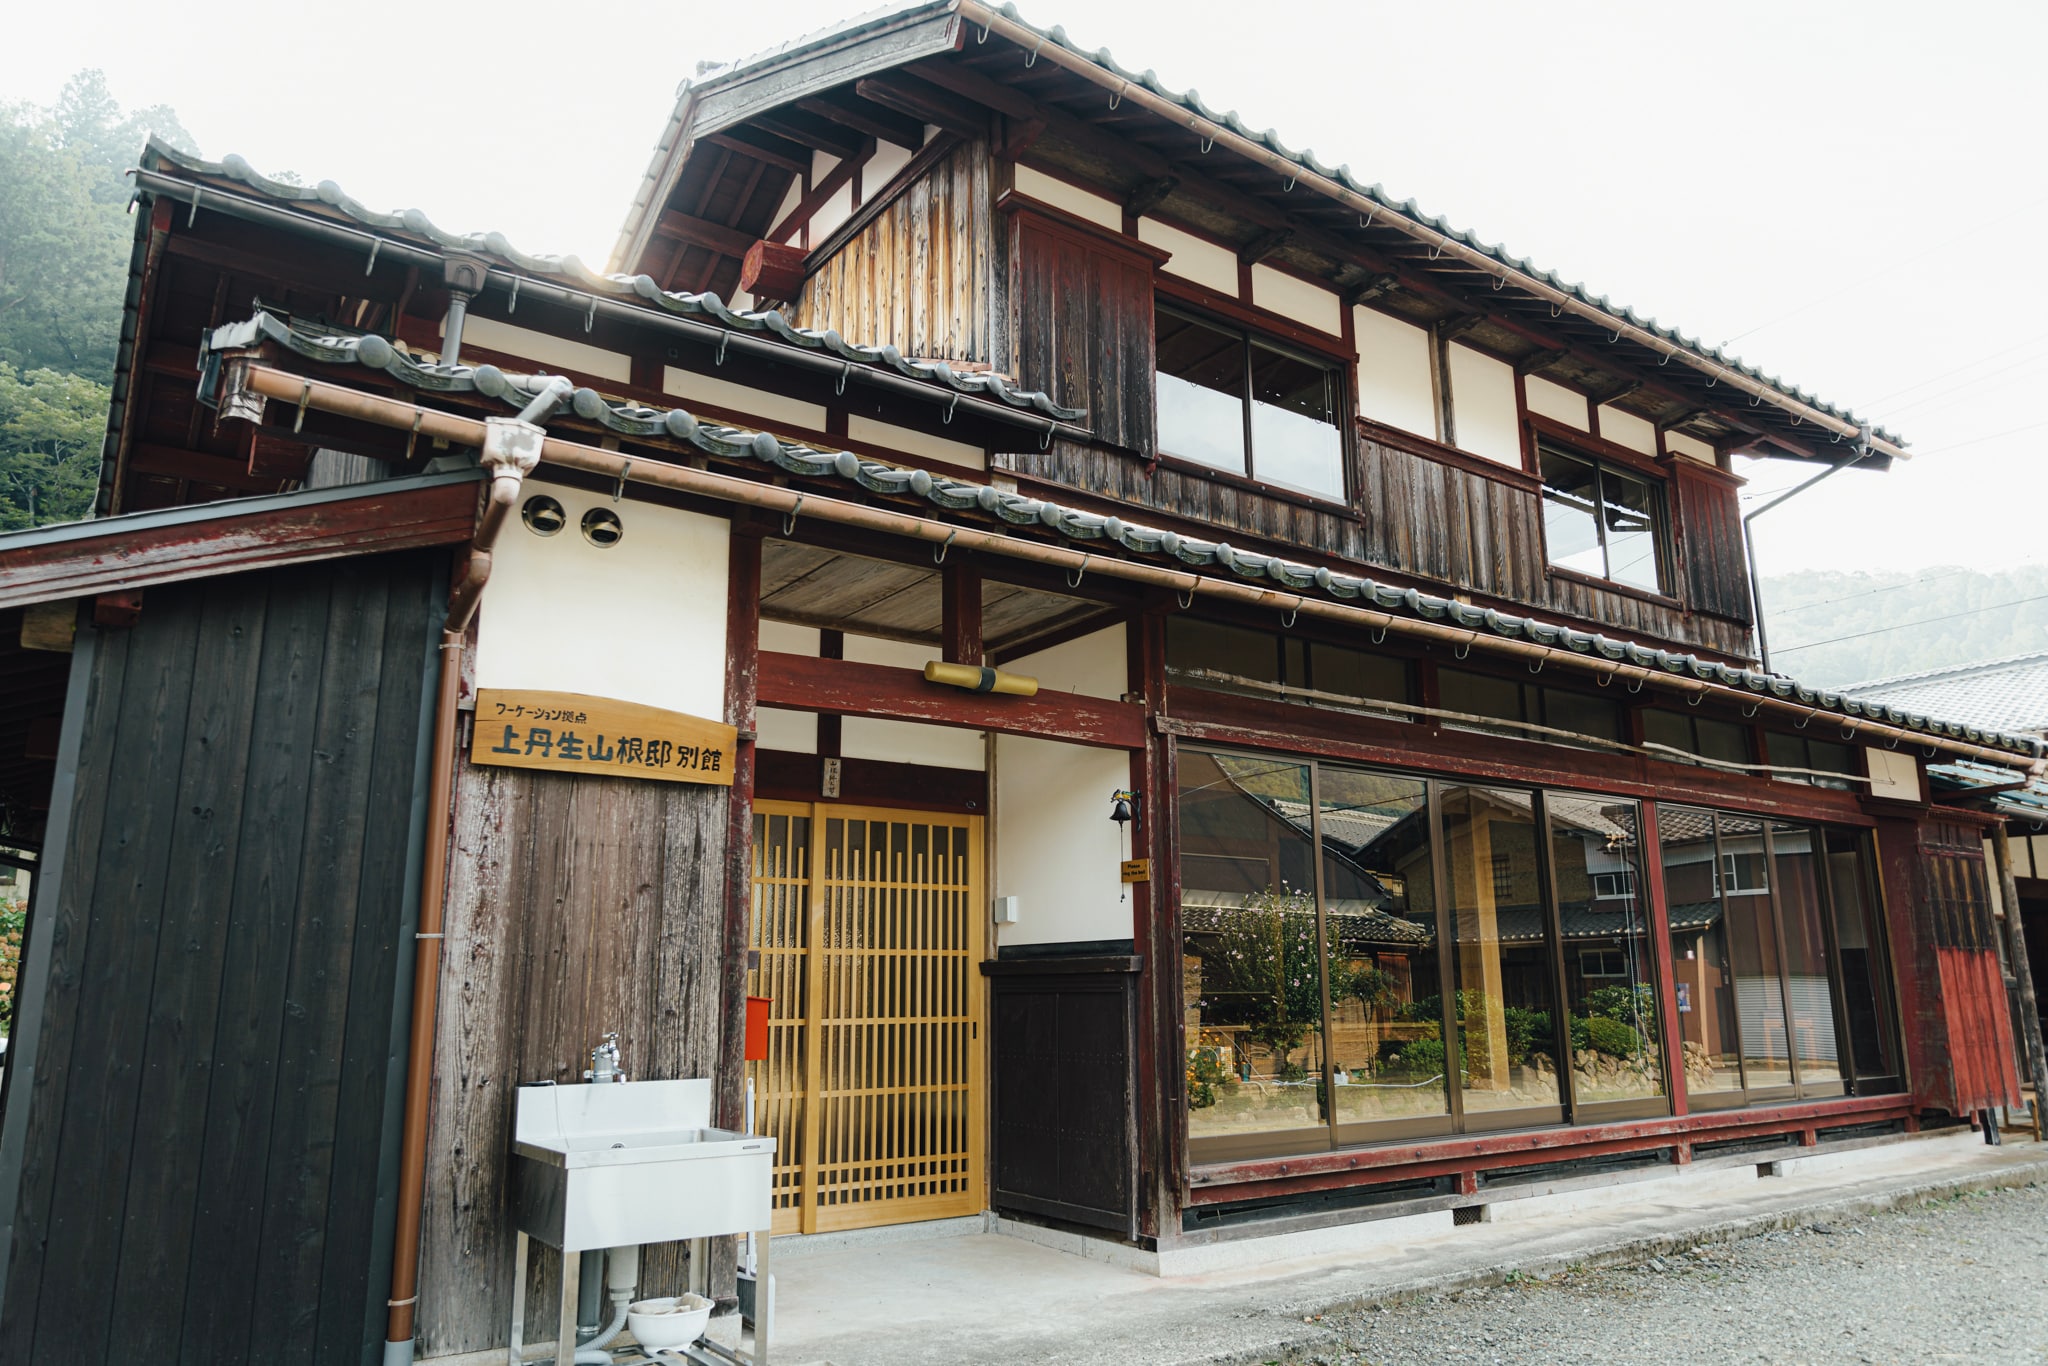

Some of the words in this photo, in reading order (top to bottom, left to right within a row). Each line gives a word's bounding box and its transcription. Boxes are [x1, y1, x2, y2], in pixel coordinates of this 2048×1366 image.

[496, 703, 587, 724] ワーケーション拠点
[491, 724, 722, 772] 上丹生山根邸別館
